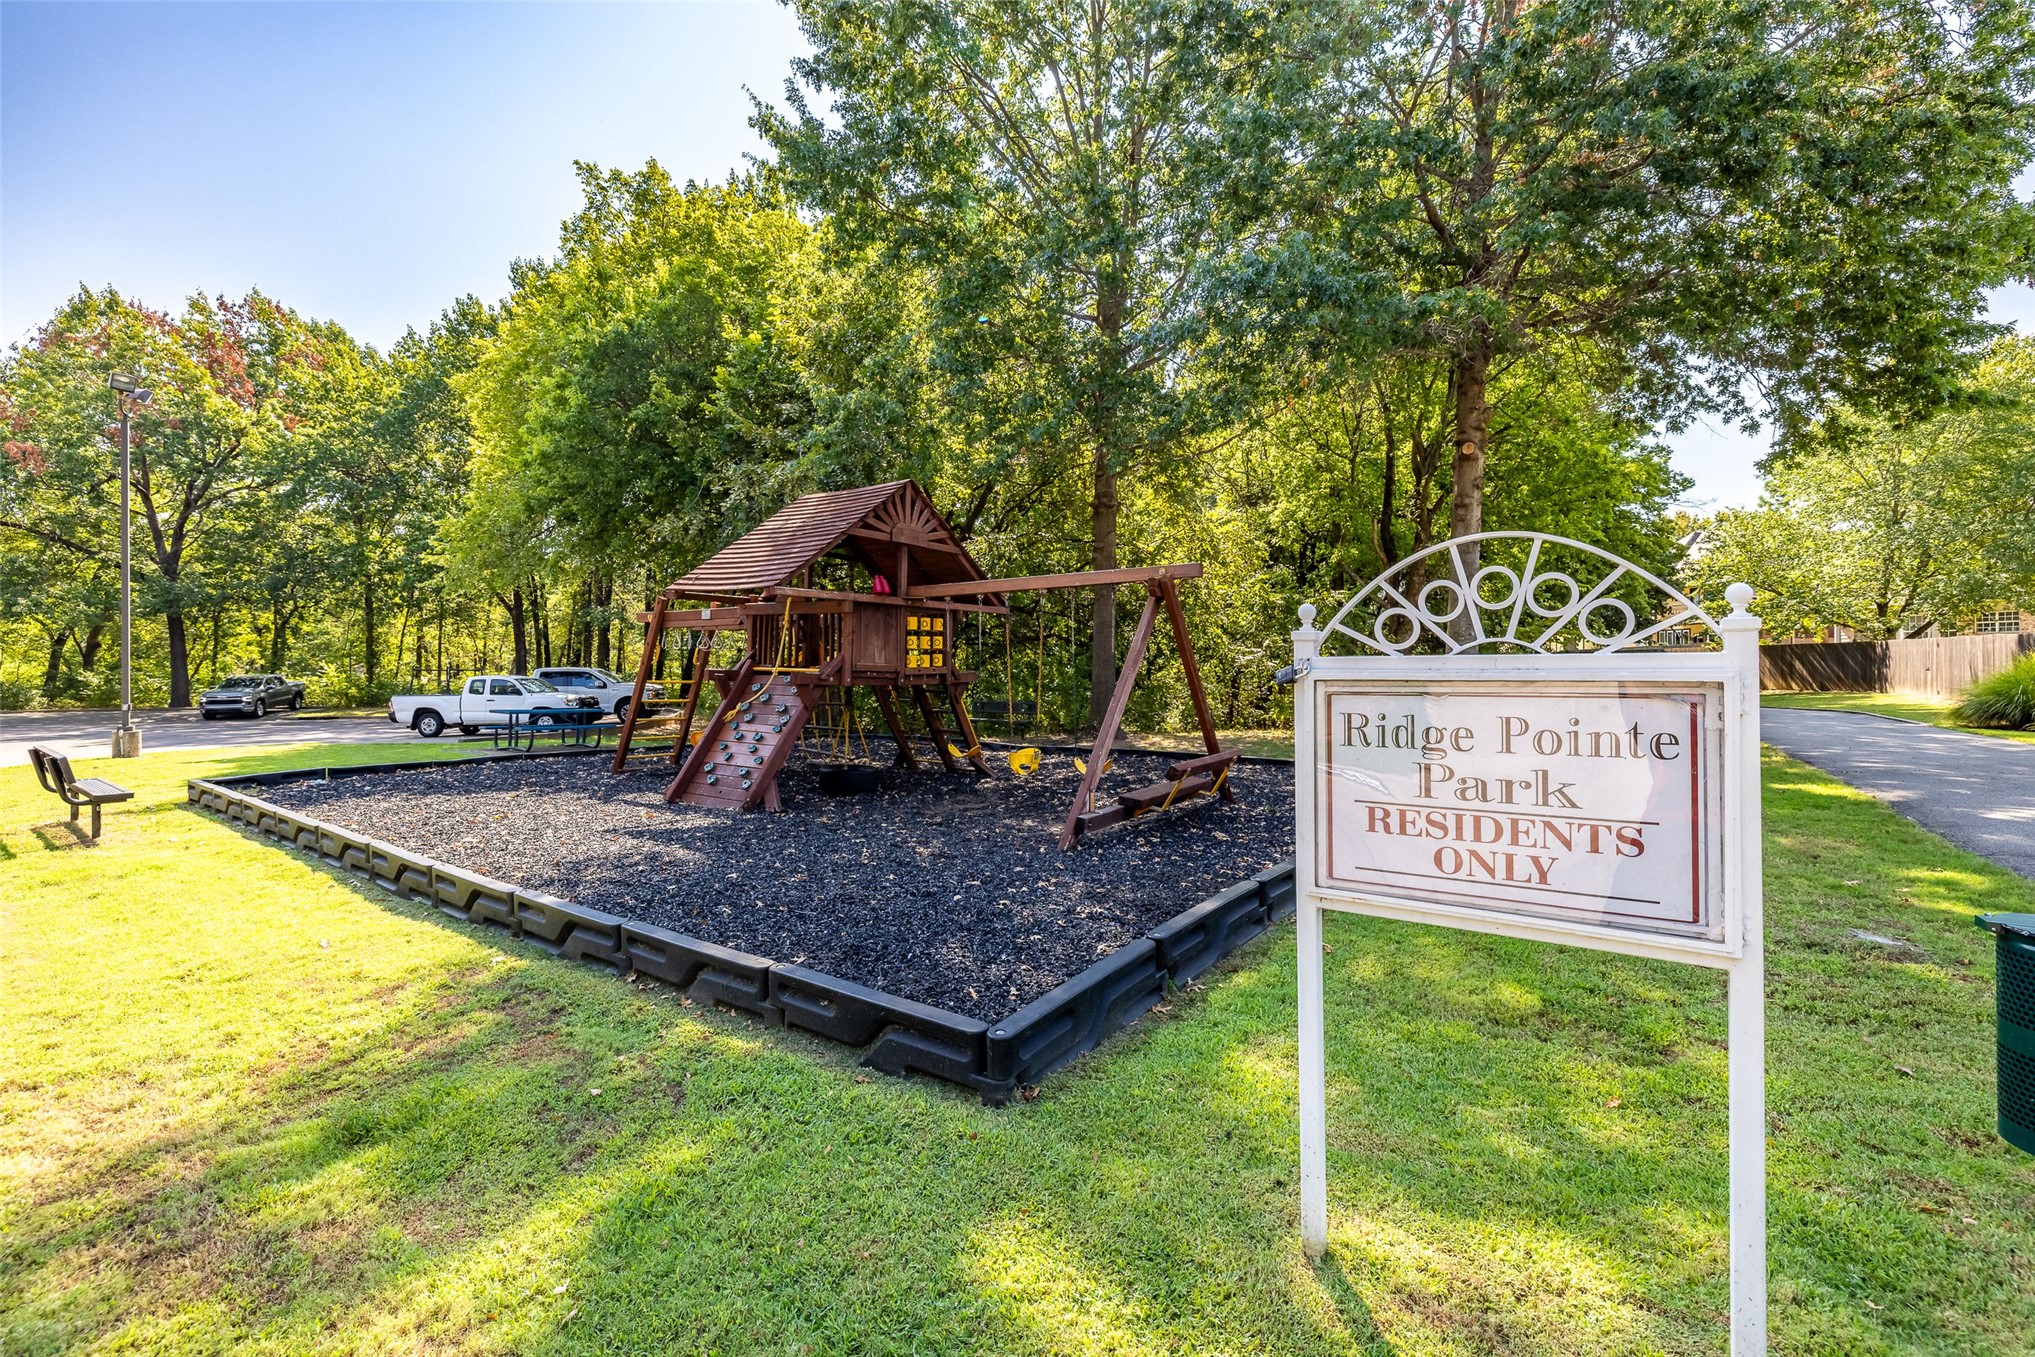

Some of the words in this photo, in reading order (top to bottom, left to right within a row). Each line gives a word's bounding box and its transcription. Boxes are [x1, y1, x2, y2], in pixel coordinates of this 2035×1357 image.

[1339, 711, 1475, 760] Ridge
[1495, 714, 1681, 761] Pointe
[1412, 761, 1583, 810] Park
[1365, 805, 1645, 858] RESIDENTS
[1433, 846, 1558, 886] ONLY
